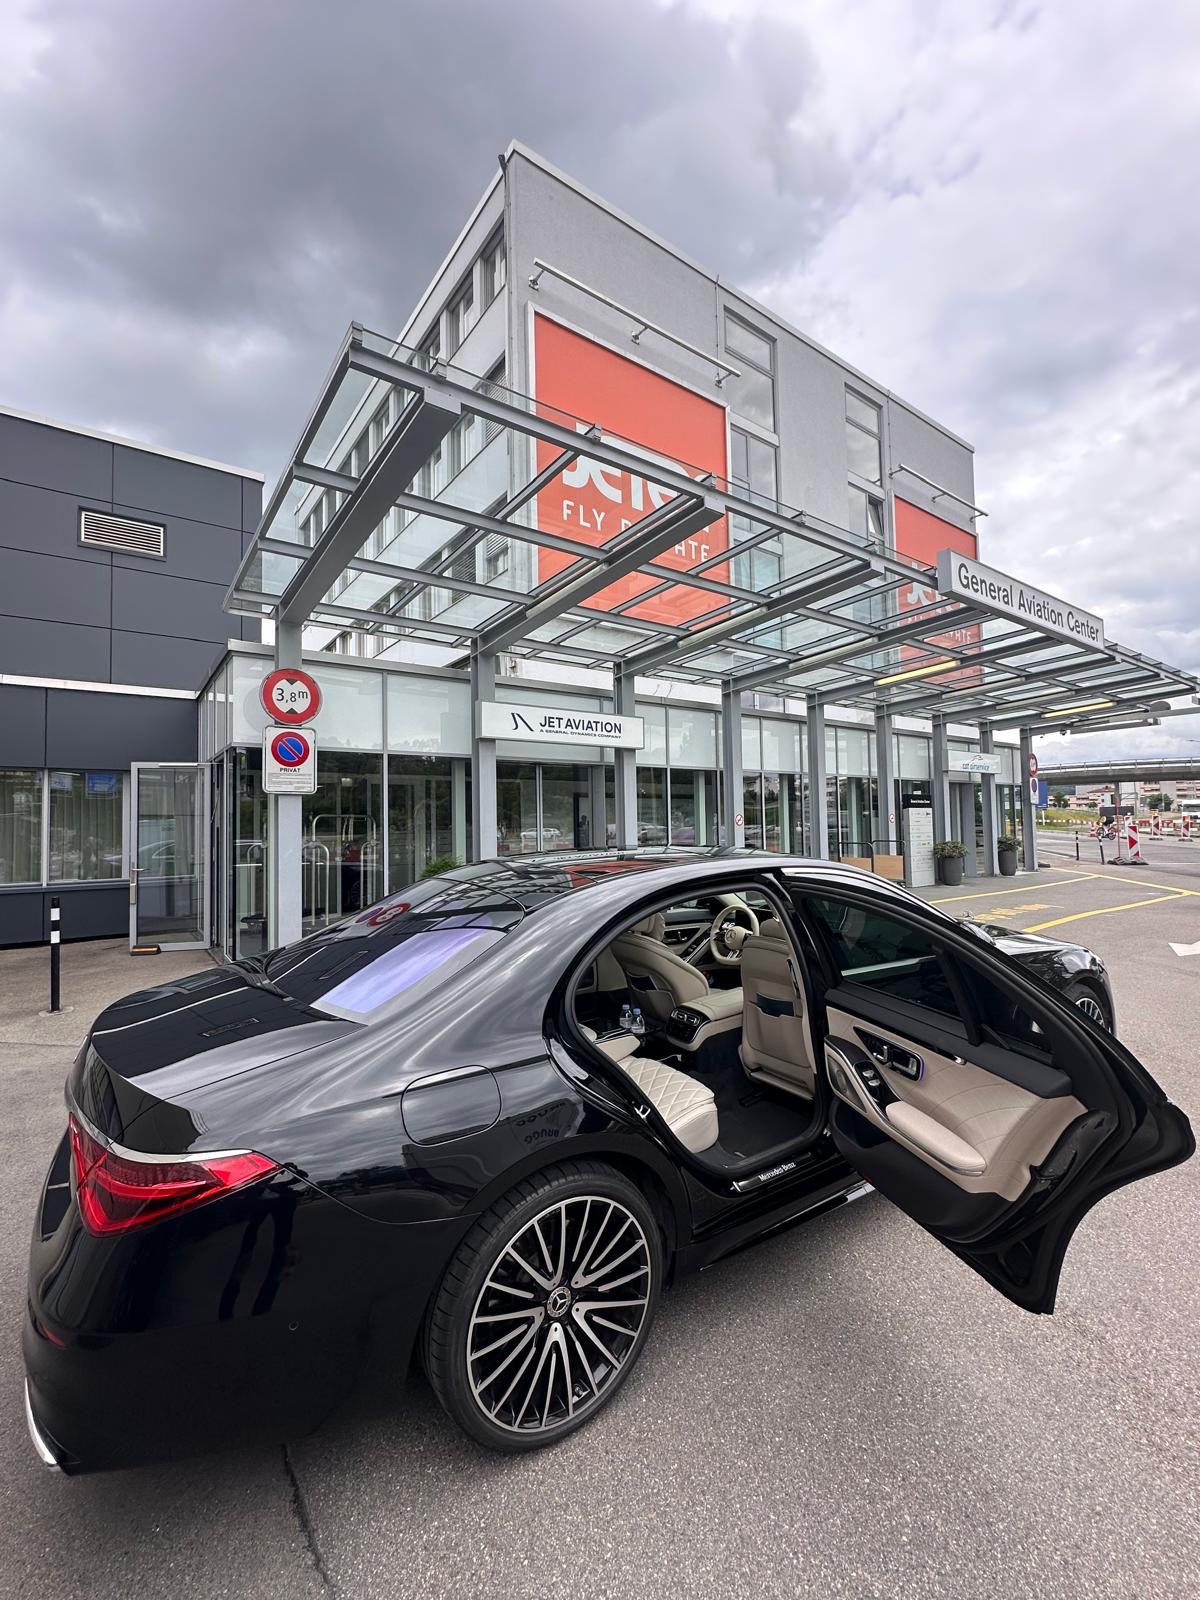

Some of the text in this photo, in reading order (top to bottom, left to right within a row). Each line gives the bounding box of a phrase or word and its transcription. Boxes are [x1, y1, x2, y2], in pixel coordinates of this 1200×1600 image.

[563, 500, 606, 531] FLY
[958, 563, 1013, 607] General
[1018, 590, 1064, 627] Aviation
[1067, 611, 1099, 641] Center
[539, 716, 622, 734] JET AVIATION
